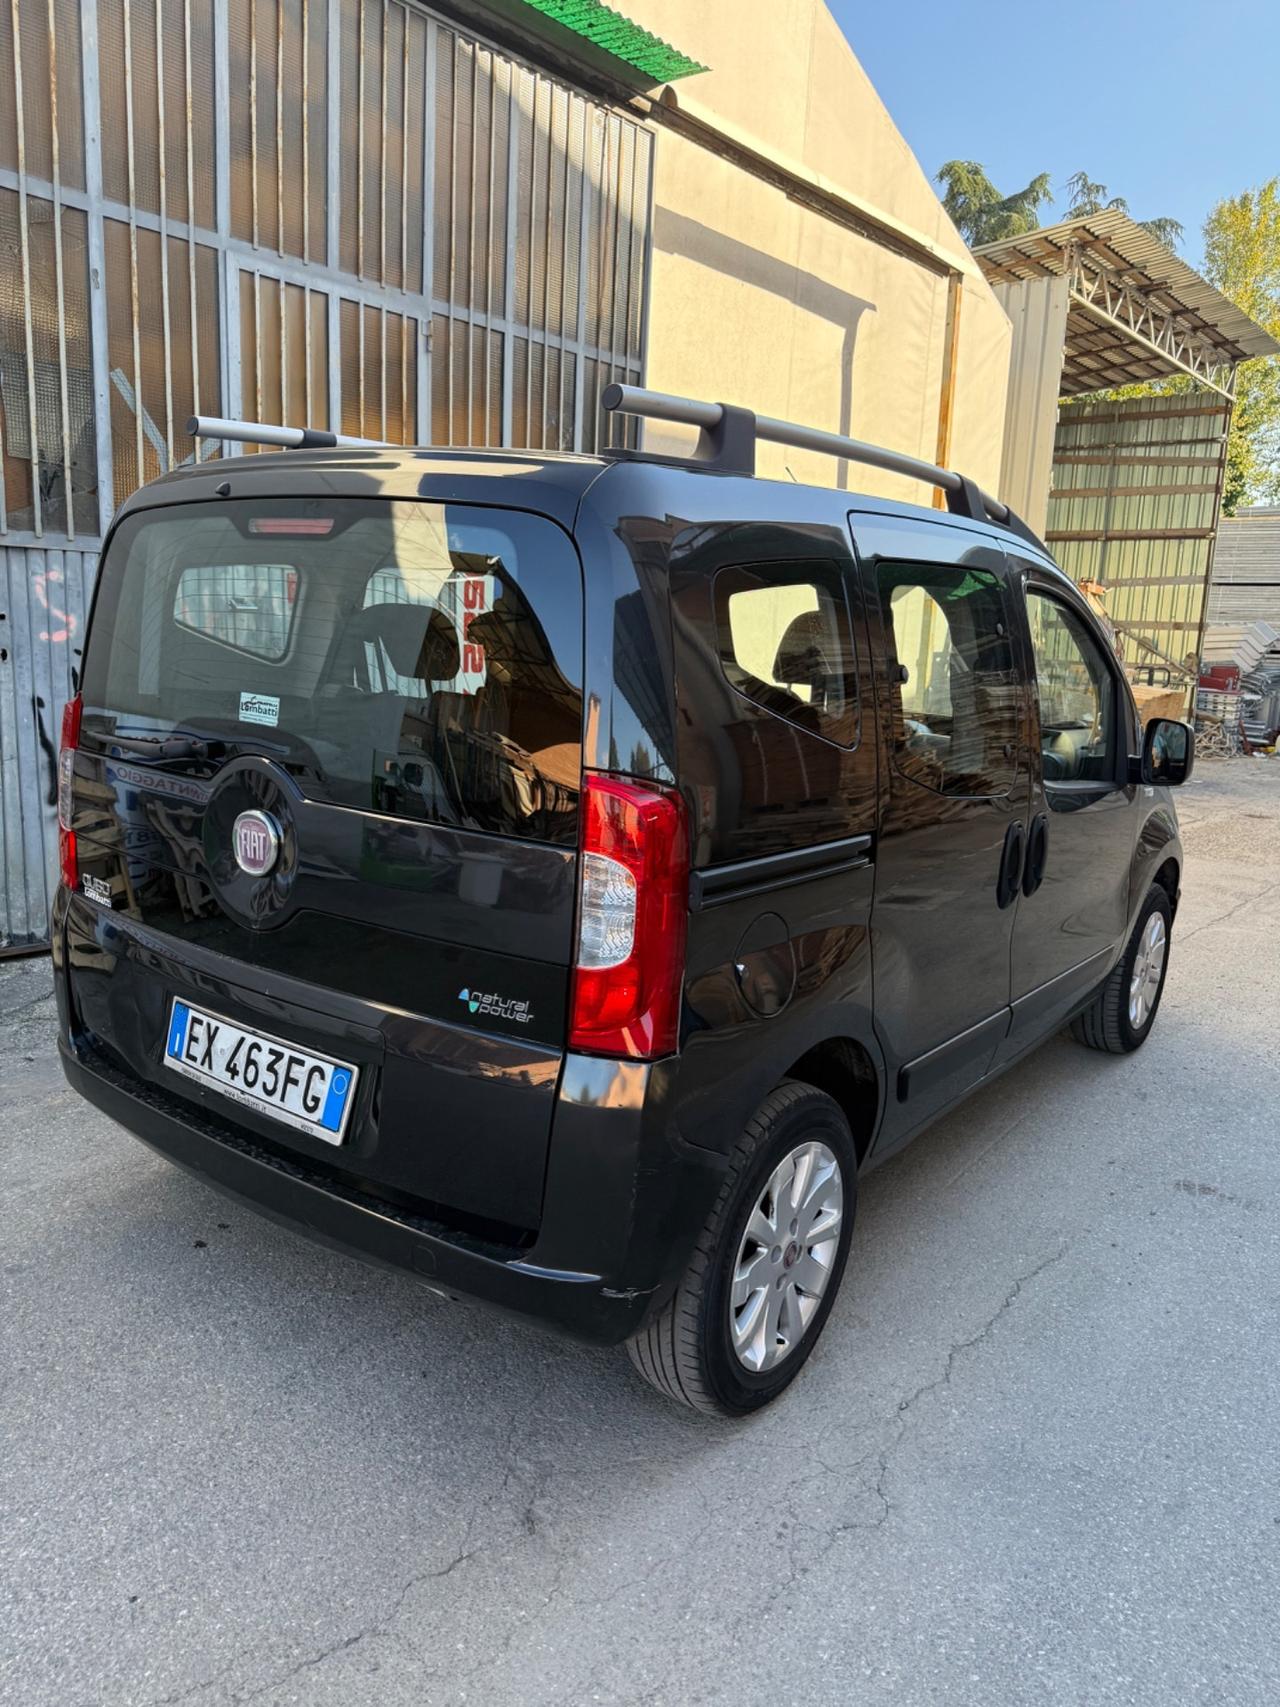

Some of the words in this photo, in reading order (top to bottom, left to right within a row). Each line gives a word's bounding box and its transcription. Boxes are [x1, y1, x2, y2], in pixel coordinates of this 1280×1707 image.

[240, 829, 267, 861] FIAT
[471, 990, 530, 1012] natural
[478, 1003, 535, 1023] power
[184, 1015, 220, 1071] EX
[224, 1036, 326, 1114] 463FG
